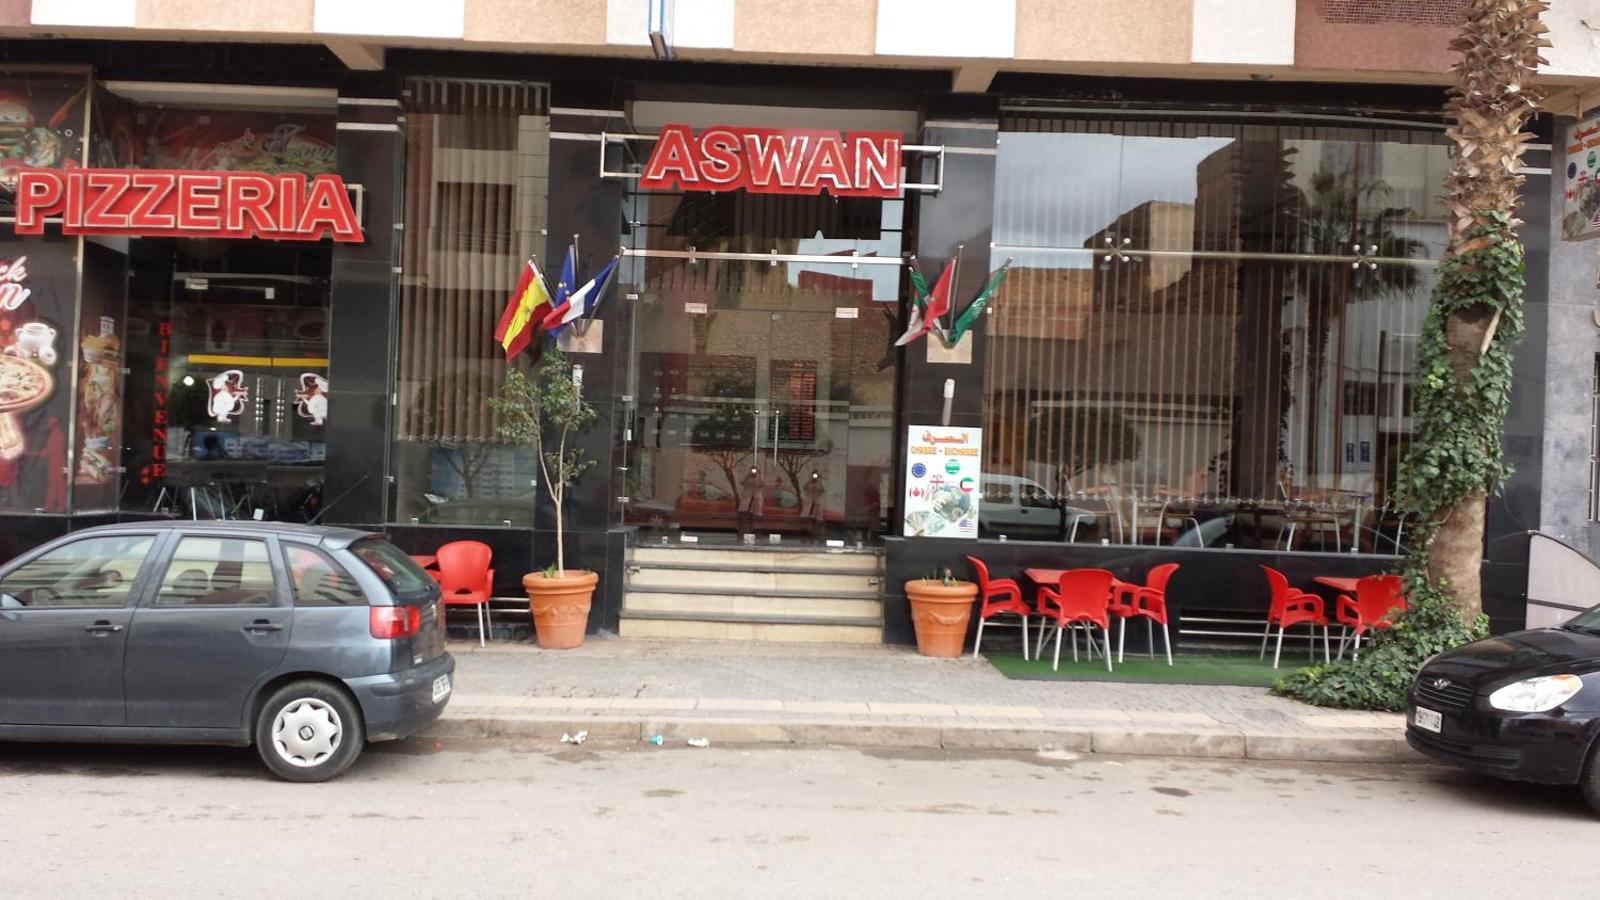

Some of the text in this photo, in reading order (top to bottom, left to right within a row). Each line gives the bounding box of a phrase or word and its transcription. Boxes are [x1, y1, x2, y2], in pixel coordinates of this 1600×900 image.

[644, 127, 902, 195] ASWAN
[16, 170, 361, 239] PIZZERIA
[152, 322, 172, 478] BIENVENUE
